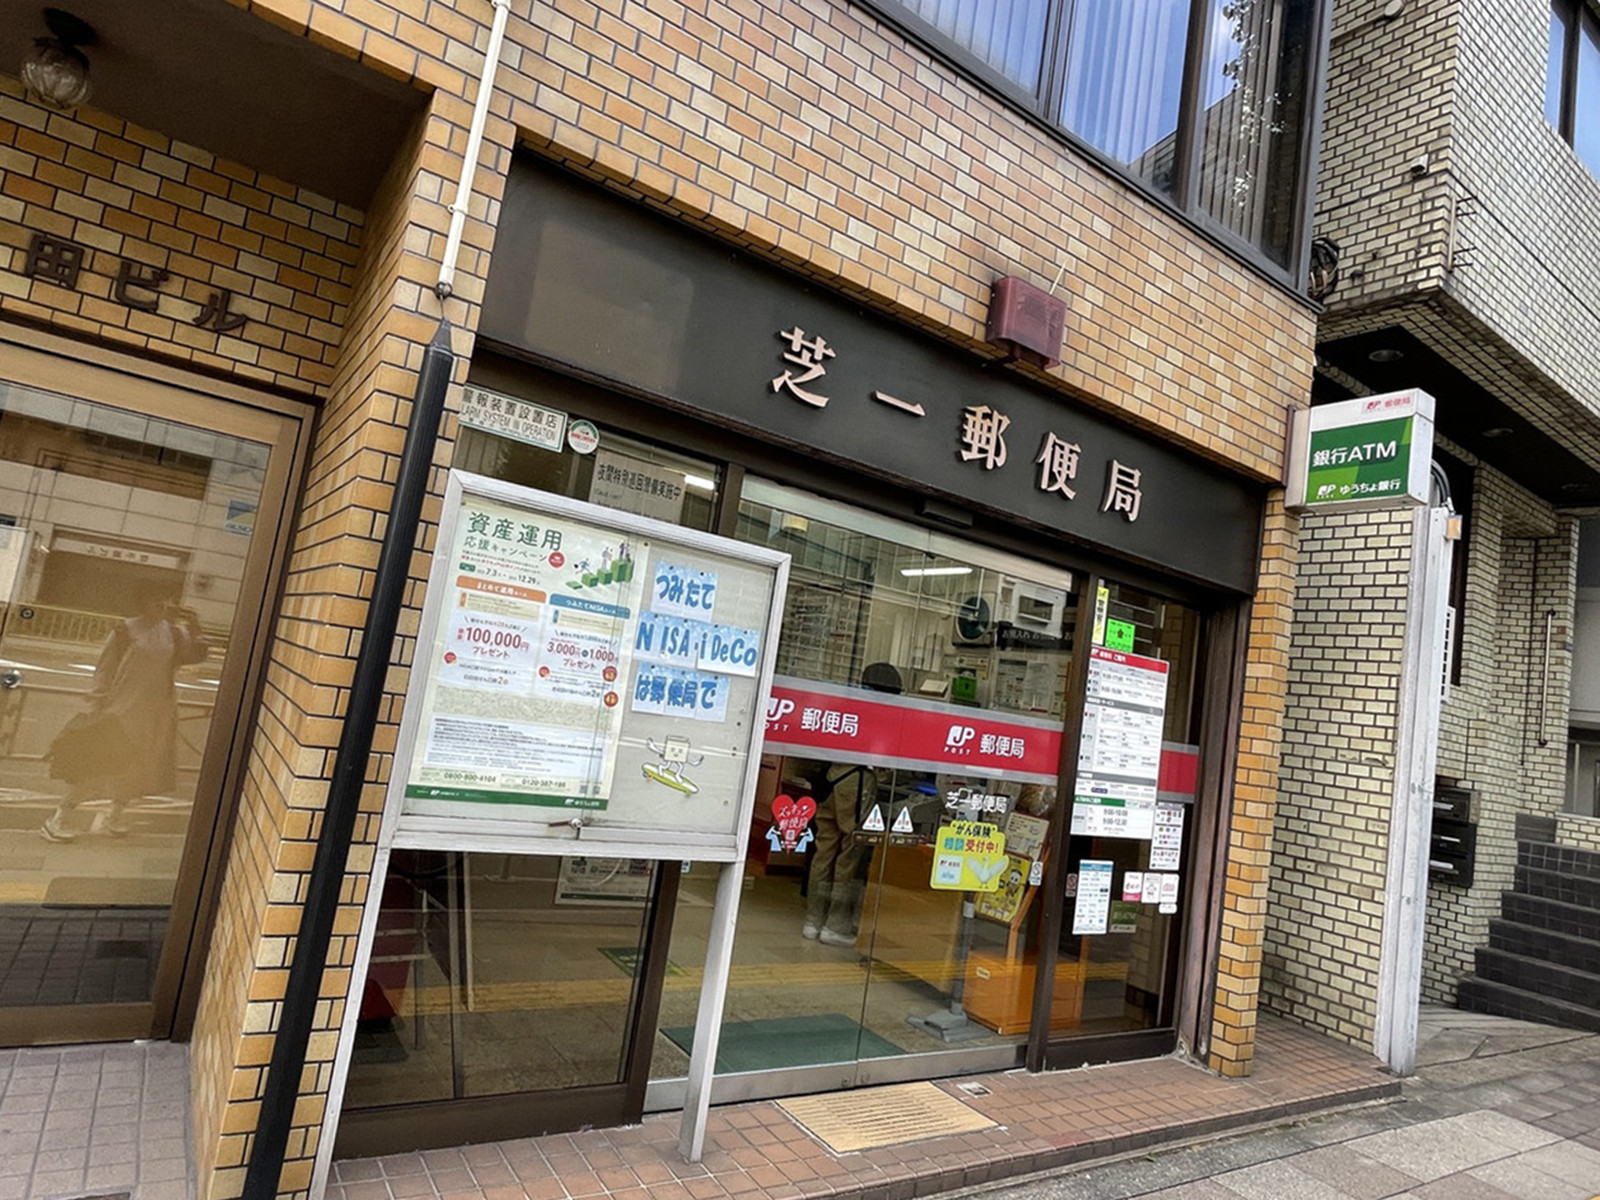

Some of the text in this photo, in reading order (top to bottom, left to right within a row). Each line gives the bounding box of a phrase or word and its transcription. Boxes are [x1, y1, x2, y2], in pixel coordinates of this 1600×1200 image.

[461, 403, 482, 419] LARM
[772, 326, 1143, 522] 芝一郵便局
[1312, 440, 1397, 467] 銀行ATM
[1340, 478, 1402, 495] ゆうちょ銀行
[466, 511, 563, 551] 資産運用
[463, 535, 548, 562] 応援キャンペーン
[655, 574, 715, 610] つみたて
[634, 673, 718, 710] は郵便局で
[763, 722, 790, 732] OST
[800, 707, 860, 738] 郵便局
[943, 746, 972, 756] POST
[979, 733, 1026, 760] 郵便局
